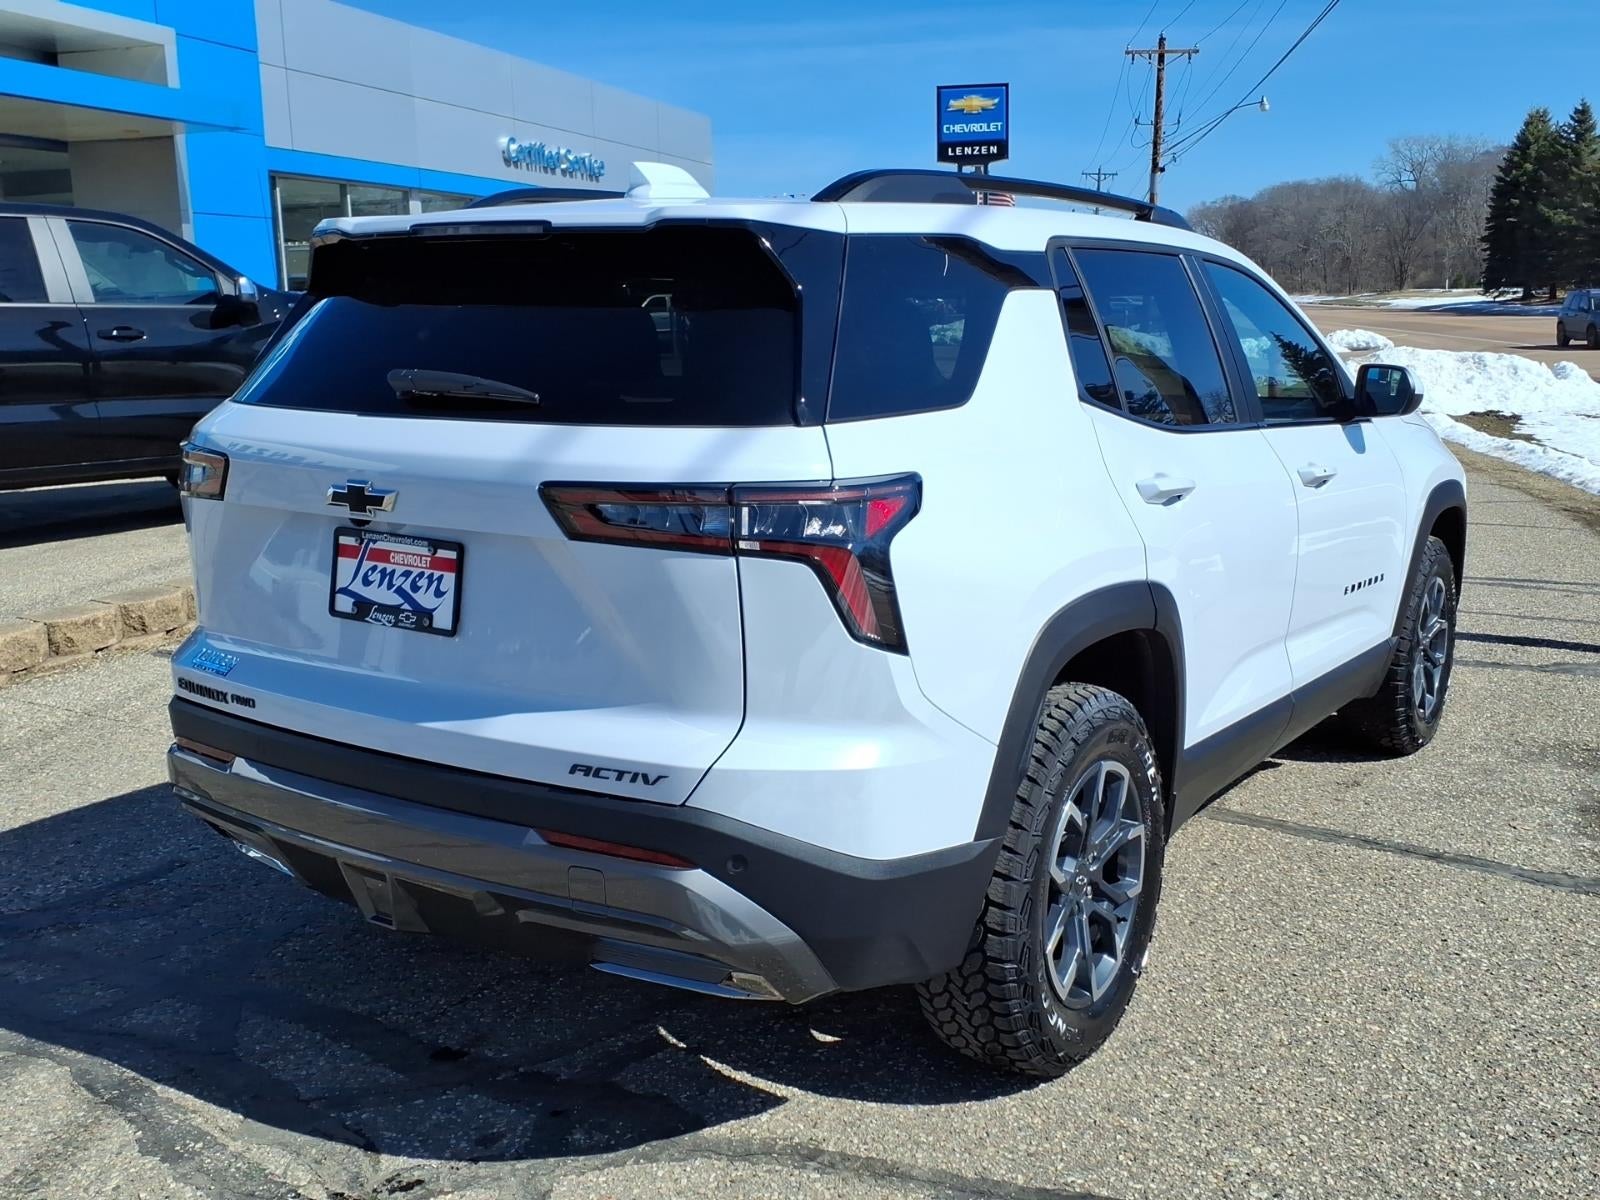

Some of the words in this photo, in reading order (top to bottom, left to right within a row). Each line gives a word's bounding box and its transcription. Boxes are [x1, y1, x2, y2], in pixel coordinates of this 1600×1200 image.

[943, 122, 1003, 134] CHEVROLET
[503, 137, 560, 172] Certified
[561, 148, 605, 178] Service
[948, 145, 998, 156] LENZEN
[361, 531, 429, 547] LenzenChevrolet.com
[389, 552, 431, 568] CHEVROLET
[335, 540, 450, 614] Lenzen
[364, 605, 396, 627] Lenzen
[177, 677, 229, 704] EQUINOX
[568, 763, 670, 786] ACTIV
